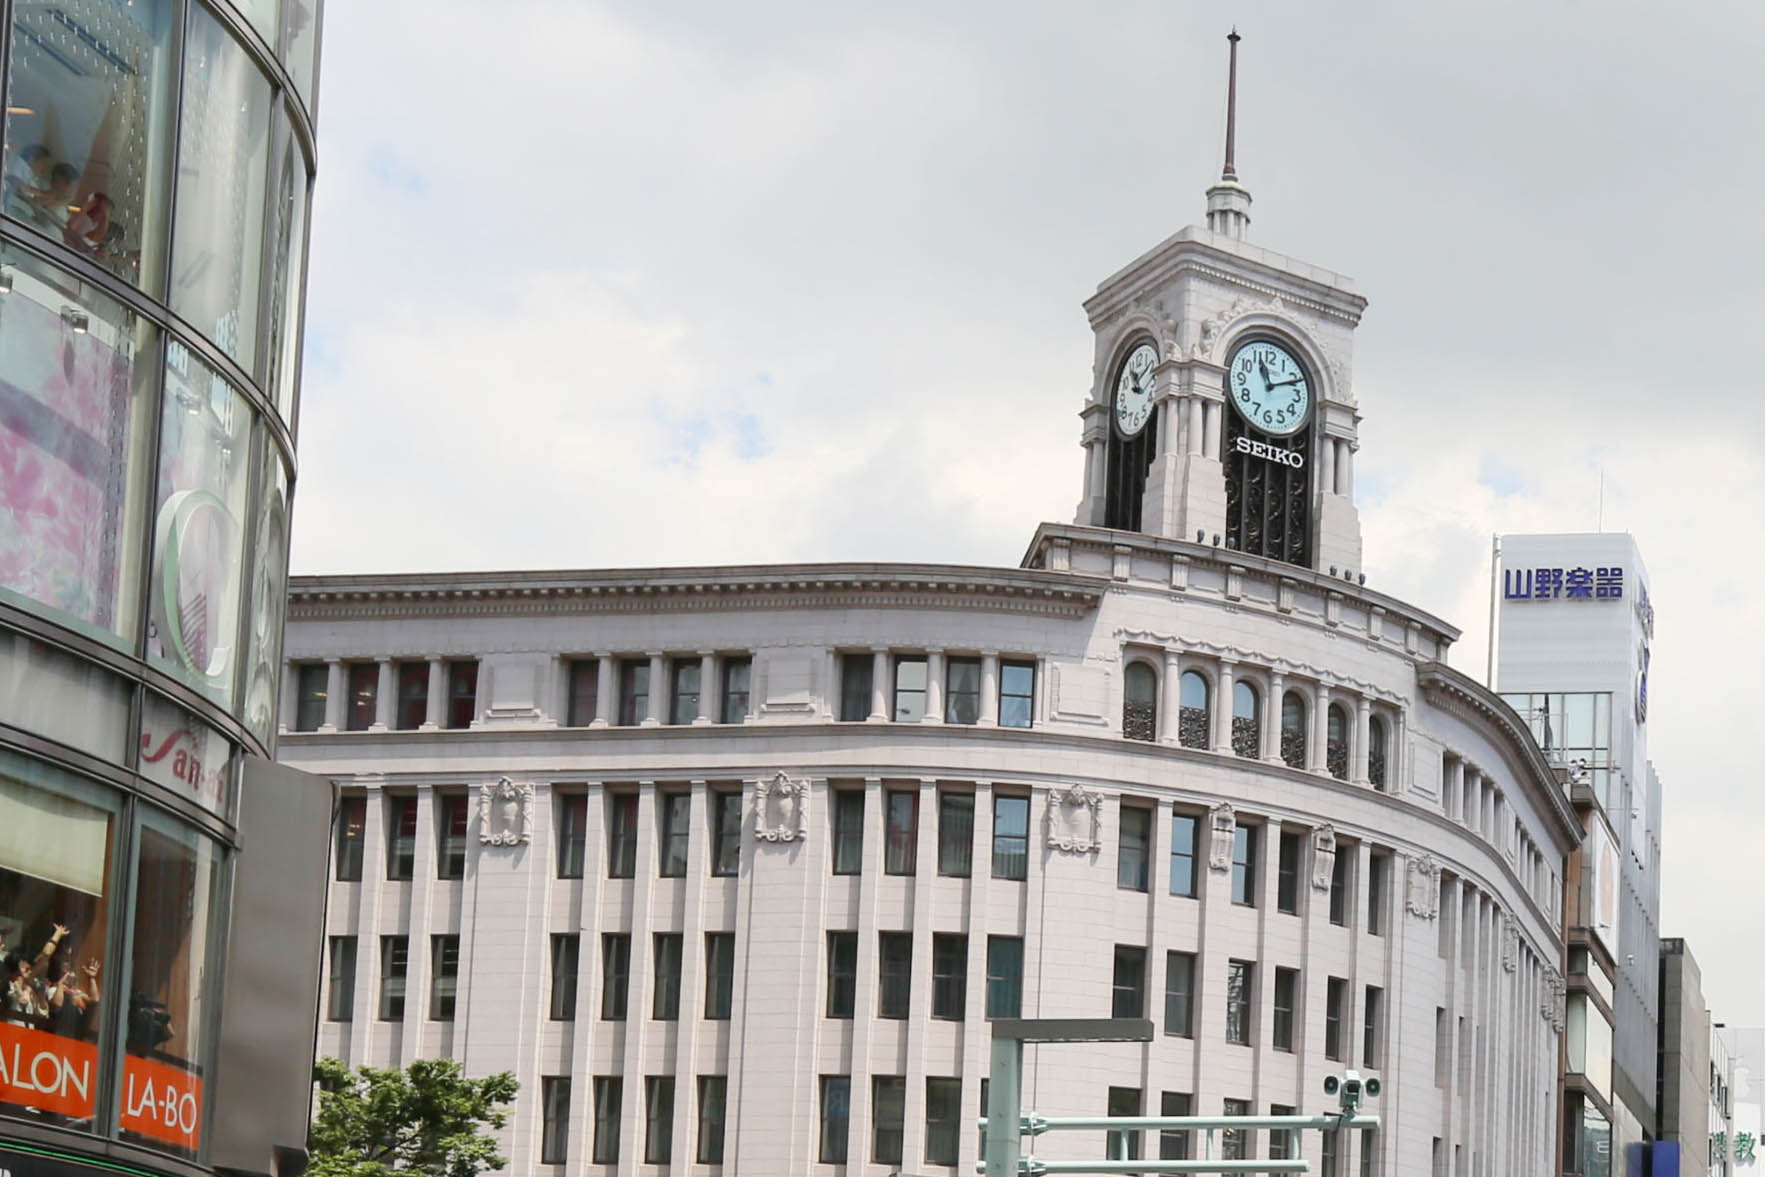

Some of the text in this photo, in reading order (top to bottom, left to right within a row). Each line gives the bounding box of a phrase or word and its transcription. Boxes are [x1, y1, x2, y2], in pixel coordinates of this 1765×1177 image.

[1241, 358, 1253, 373] 10
[1265, 351, 1277, 366] 12
[1282, 359, 1286, 373] 1
[1236, 372, 1246, 386] 9
[1241, 388, 1251, 403] 8
[1292, 389, 1301, 403] 3
[1252, 402, 1262, 416] 7
[1286, 403, 1296, 416] 4
[1263, 410, 1272, 424] 6
[1276, 410, 1285, 424] 5
[1236, 436, 1304, 469] SEIKO
[1504, 566, 1624, 600] 山野楽器
[127, 1073, 198, 1134] LA-BO
